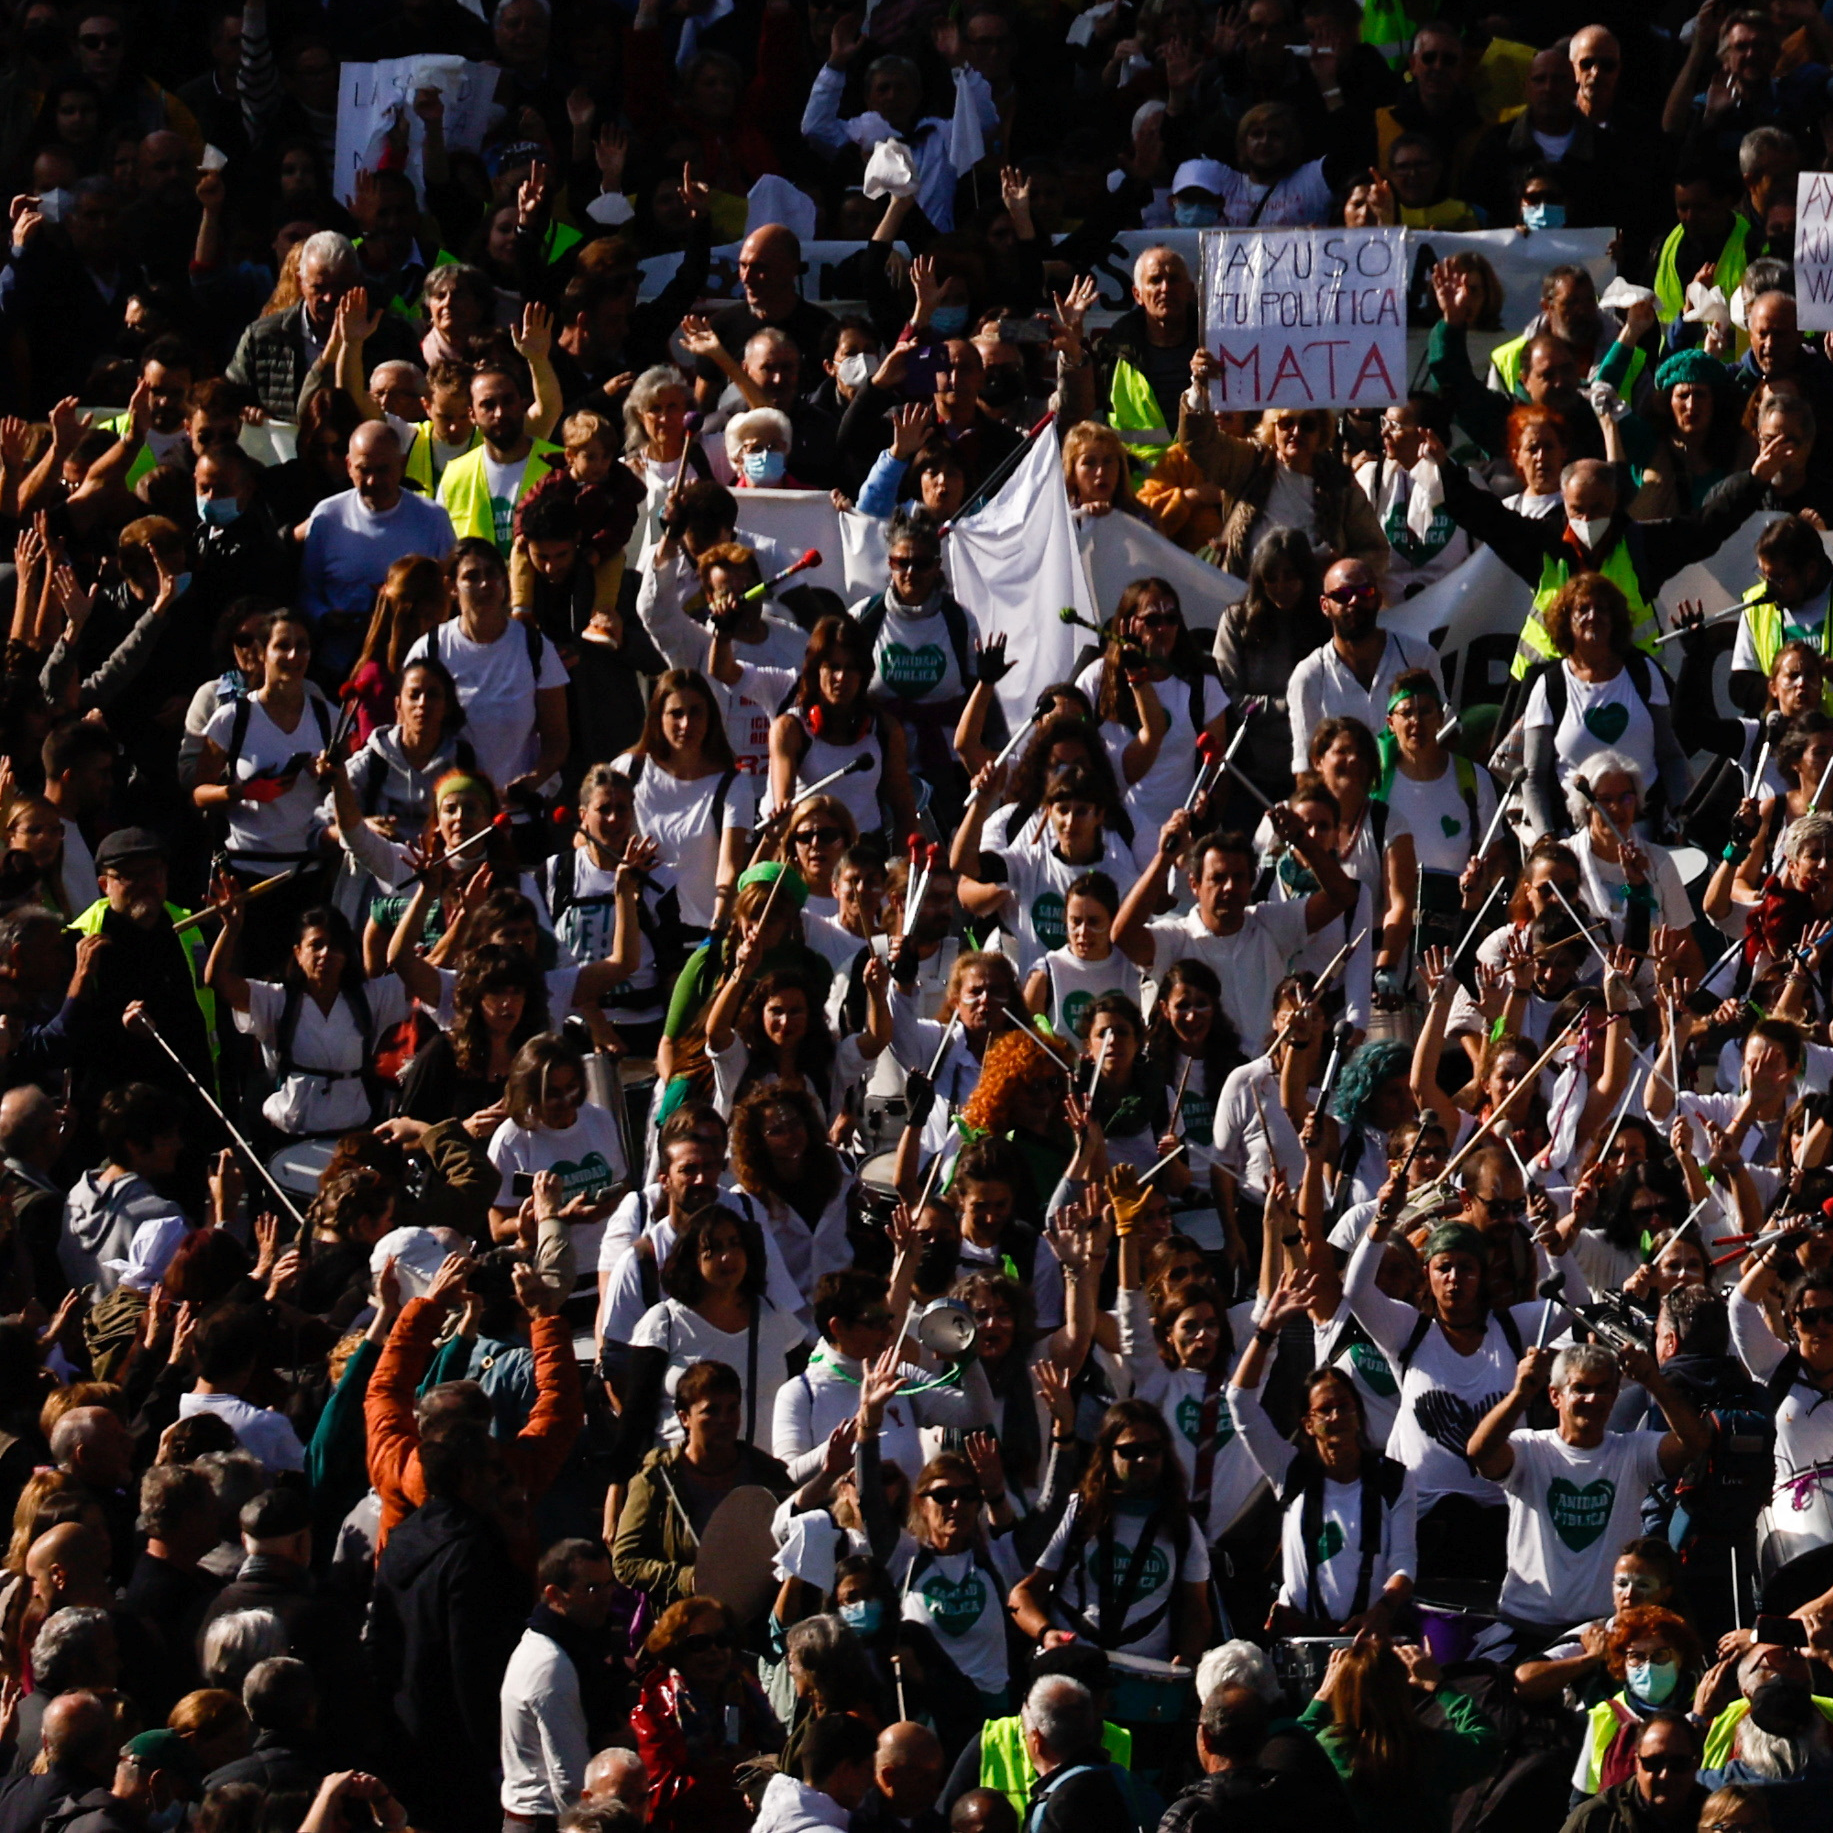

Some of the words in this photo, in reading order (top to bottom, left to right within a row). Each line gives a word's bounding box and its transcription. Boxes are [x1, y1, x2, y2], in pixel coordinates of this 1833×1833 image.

[1223, 239, 1393, 280] AYUSO
[1214, 291, 1248, 326] TU
[1219, 340, 1398, 402] MATA
[1557, 1493, 1609, 1510] ANIDAD
